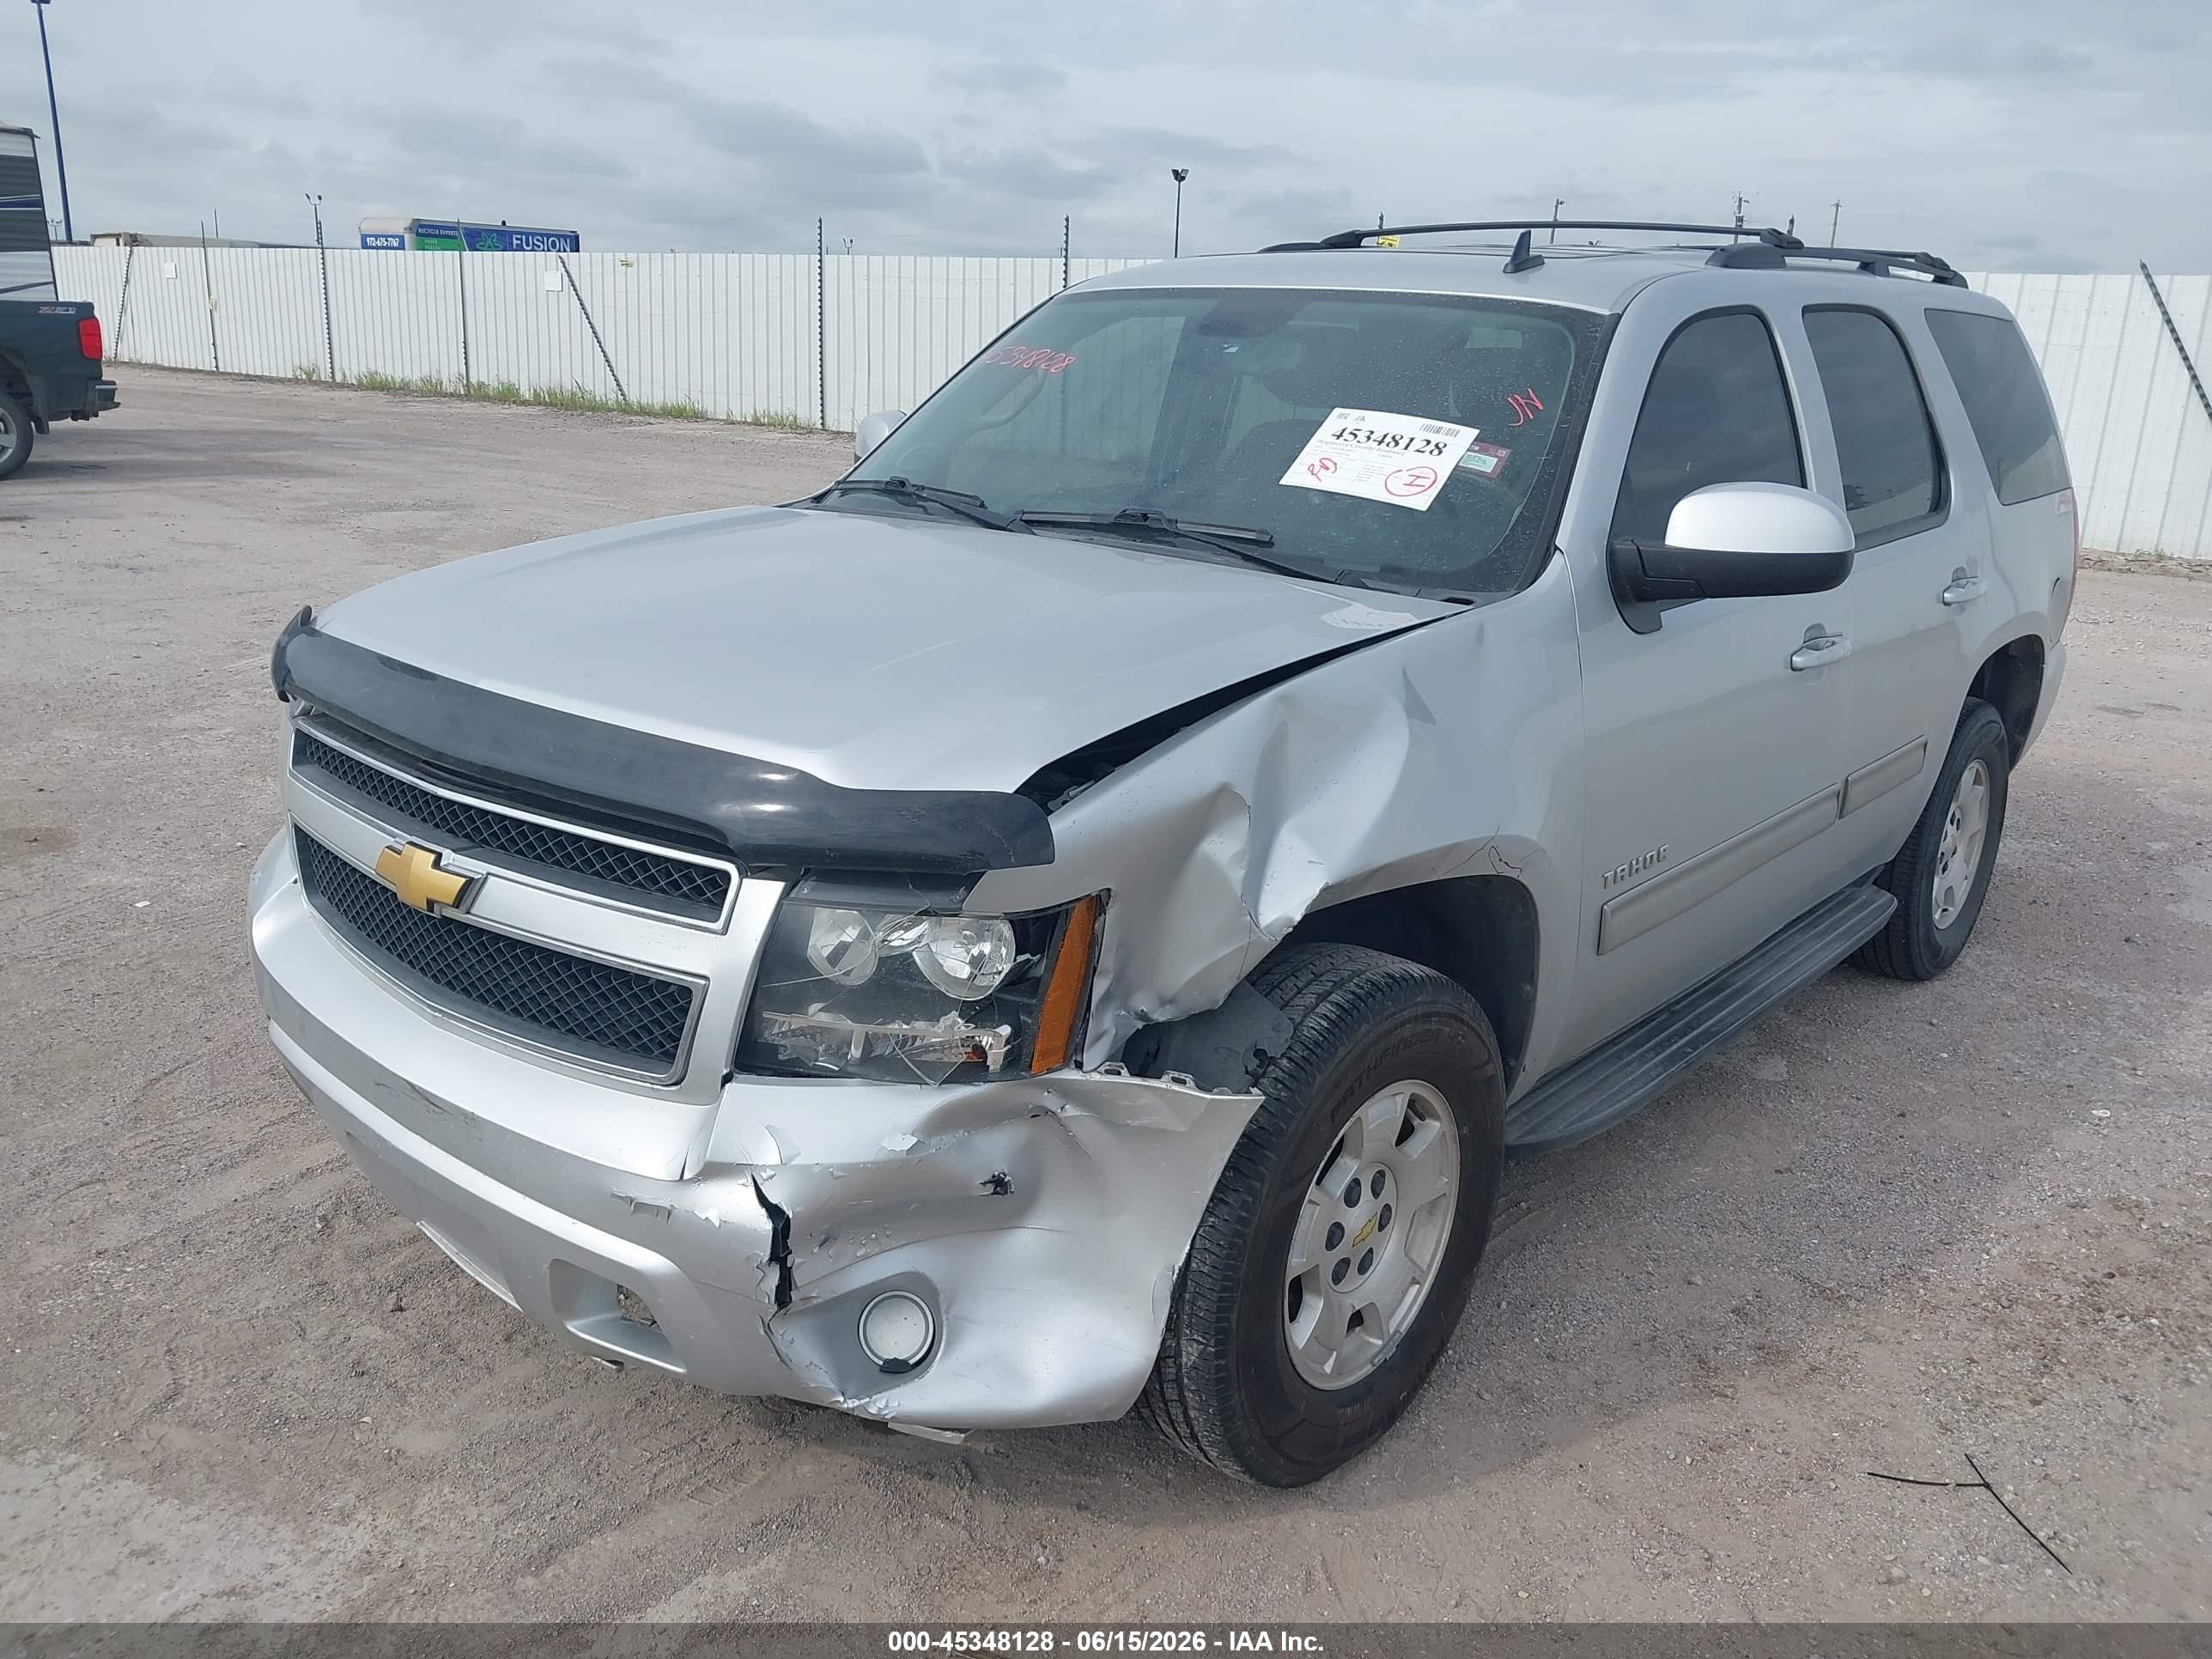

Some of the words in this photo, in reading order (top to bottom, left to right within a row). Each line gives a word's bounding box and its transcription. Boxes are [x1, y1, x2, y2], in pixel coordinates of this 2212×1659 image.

[512, 234, 570, 252] FUSION
[1330, 426, 1448, 457] 45348128
[1601, 843, 1668, 890] TAHOE
